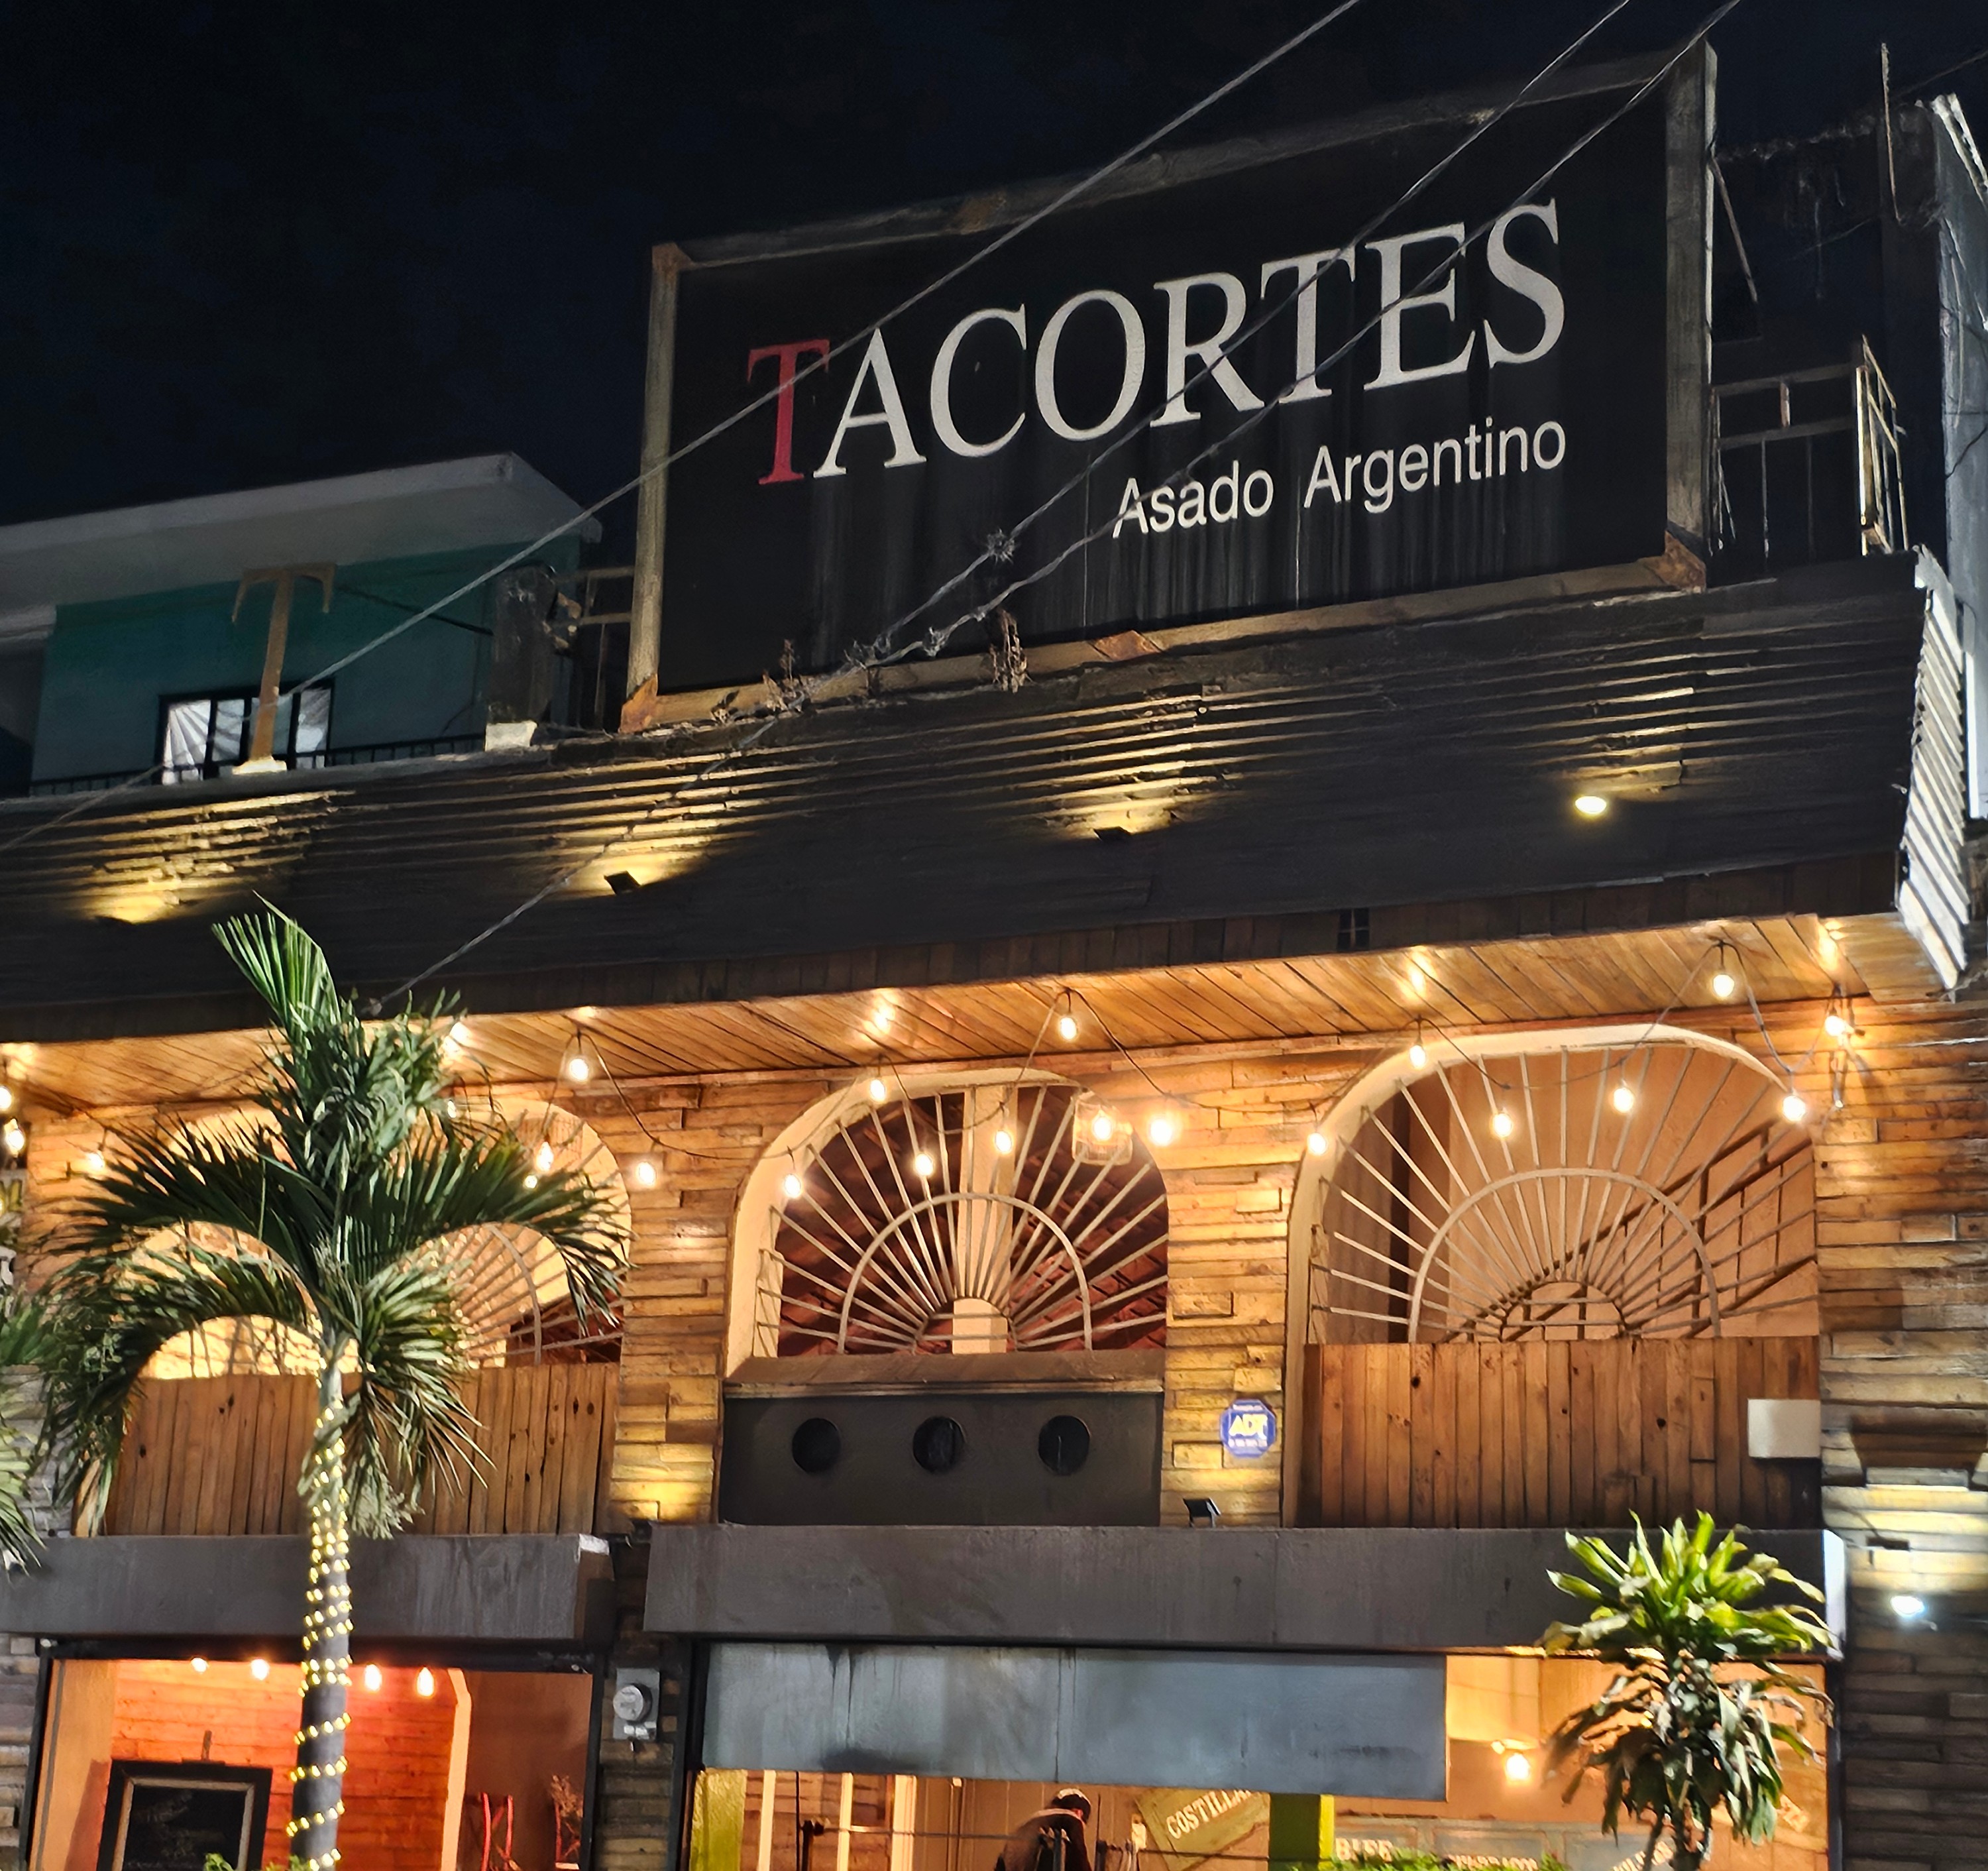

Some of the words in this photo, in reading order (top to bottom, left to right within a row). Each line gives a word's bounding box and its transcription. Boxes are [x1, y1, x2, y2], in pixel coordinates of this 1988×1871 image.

[747, 199, 1565, 484] TACORTES
[1113, 460, 1274, 538] Asado
[1304, 417, 1566, 513] Argentino
[1229, 1413, 1268, 1440] ADT
